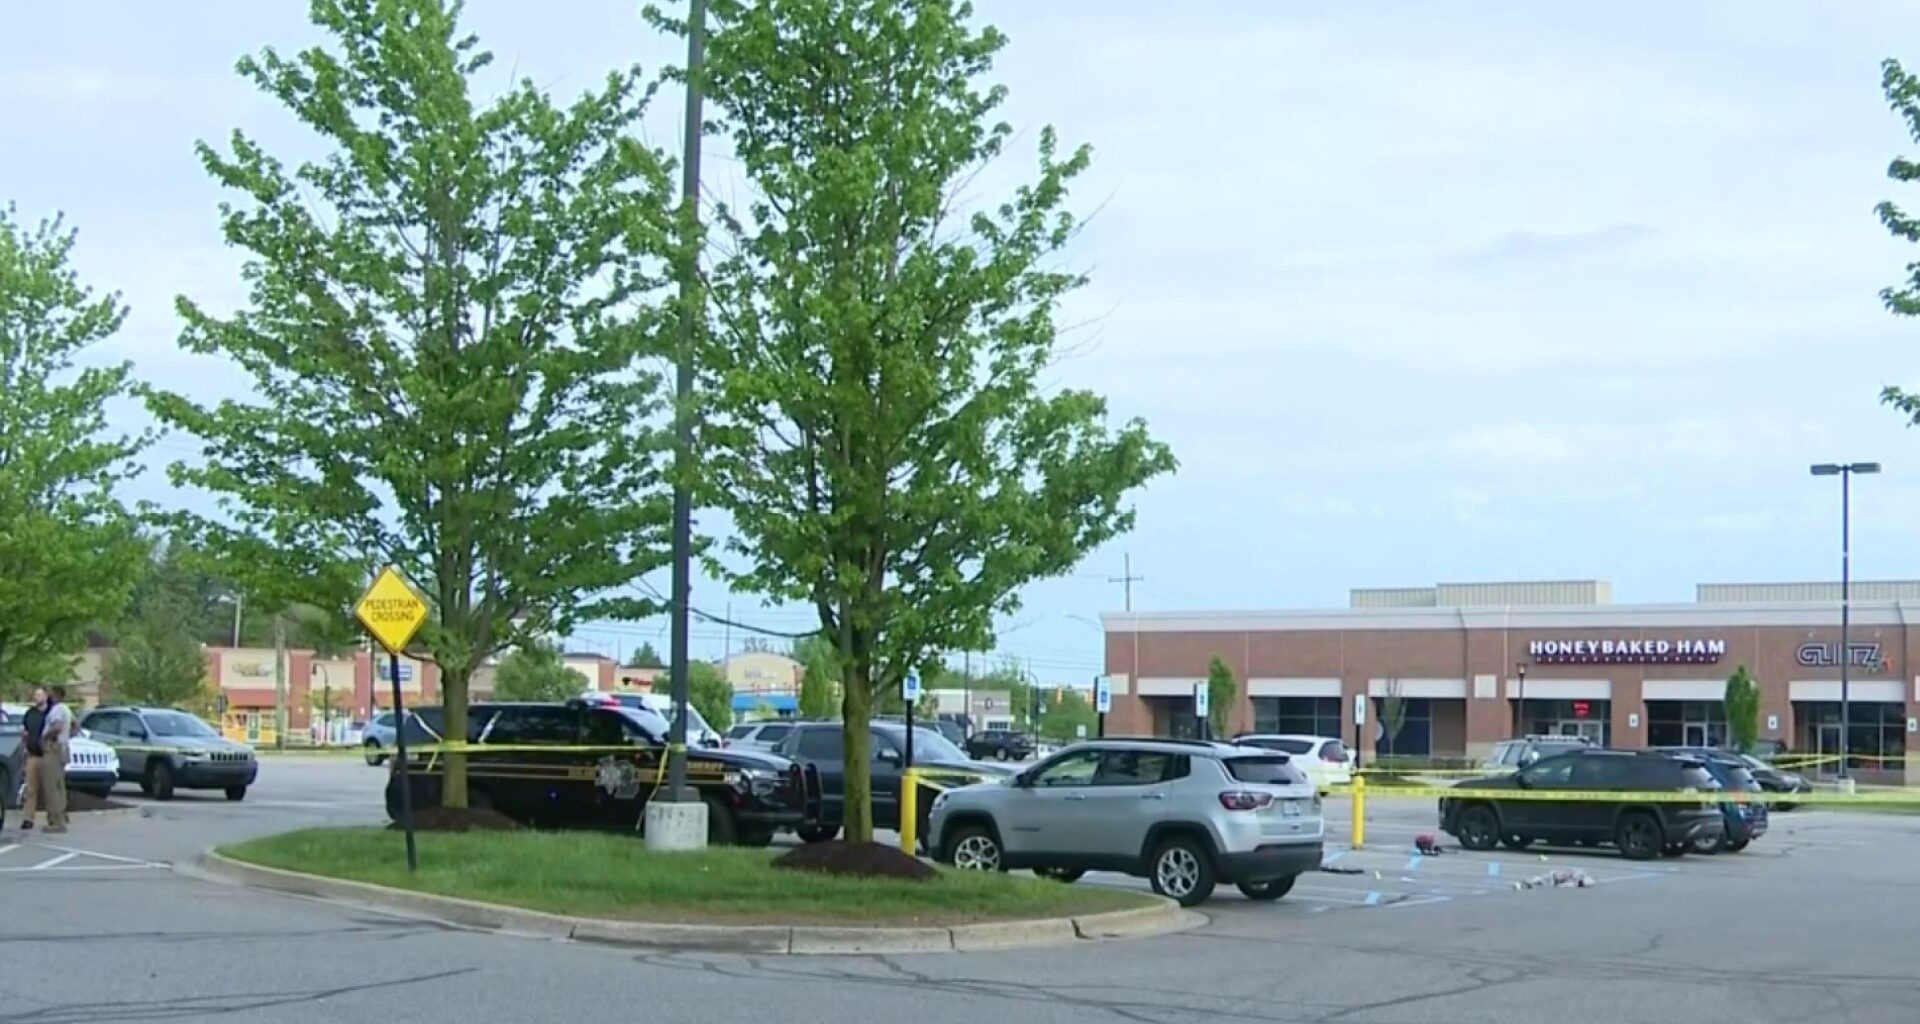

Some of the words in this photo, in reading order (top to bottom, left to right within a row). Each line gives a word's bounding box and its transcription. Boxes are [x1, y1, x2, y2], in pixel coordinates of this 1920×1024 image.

[365, 599, 418, 610] PEDESTRIAN
[371, 610, 415, 622] CROSSING
[1529, 640, 1670, 655] HONEYBAKED
[1676, 640, 1726, 654] HAM
